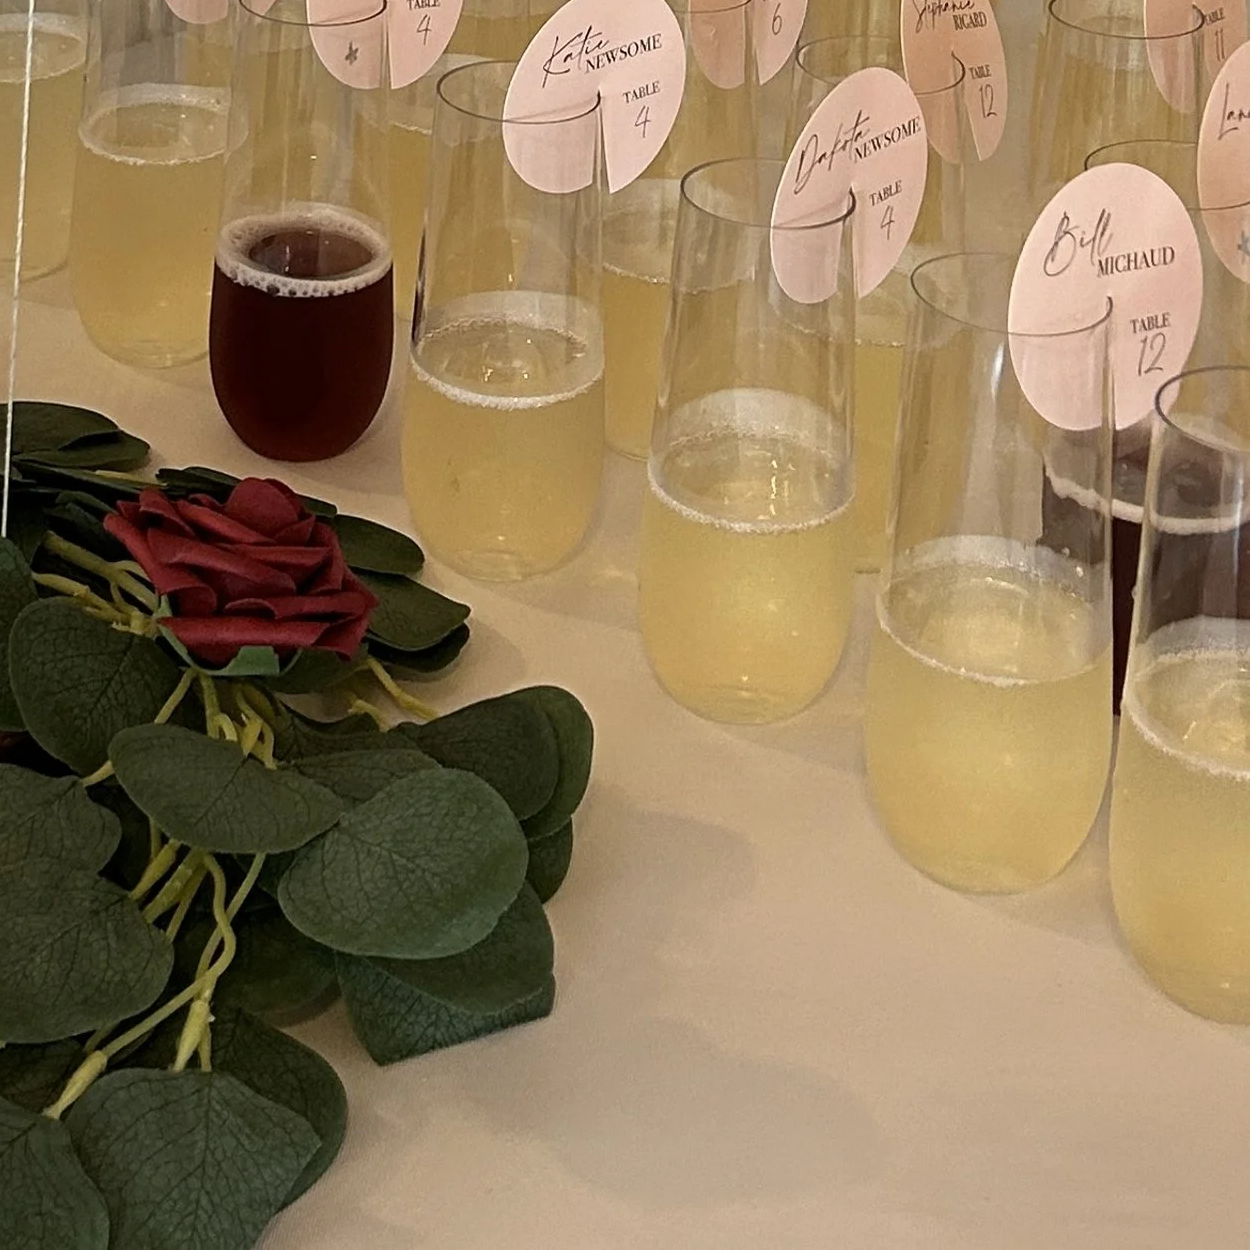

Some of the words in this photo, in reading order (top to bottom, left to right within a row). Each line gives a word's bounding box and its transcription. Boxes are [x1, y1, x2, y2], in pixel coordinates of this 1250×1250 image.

[416, 14, 433, 46] 4
[772, 2, 783, 36] 6
[952, 11, 988, 31] RICARD
[542, 24, 610, 88] Katie
[584, 33, 663, 74] NEWSOME
[969, 64, 992, 80] TABLE
[622, 80, 662, 104] TABLE
[979, 83, 998, 119] 12
[634, 104, 651, 139] 4
[793, 110, 871, 195] Dakota
[853, 115, 923, 164] NEWSOME
[869, 179, 903, 207] TABLE
[880, 204, 895, 241] 4
[1043, 208, 1115, 277] Bill
[1096, 246, 1176, 279] MICHAUD
[1130, 312, 1172, 334] TABLE
[1138, 331, 1167, 378] 12
